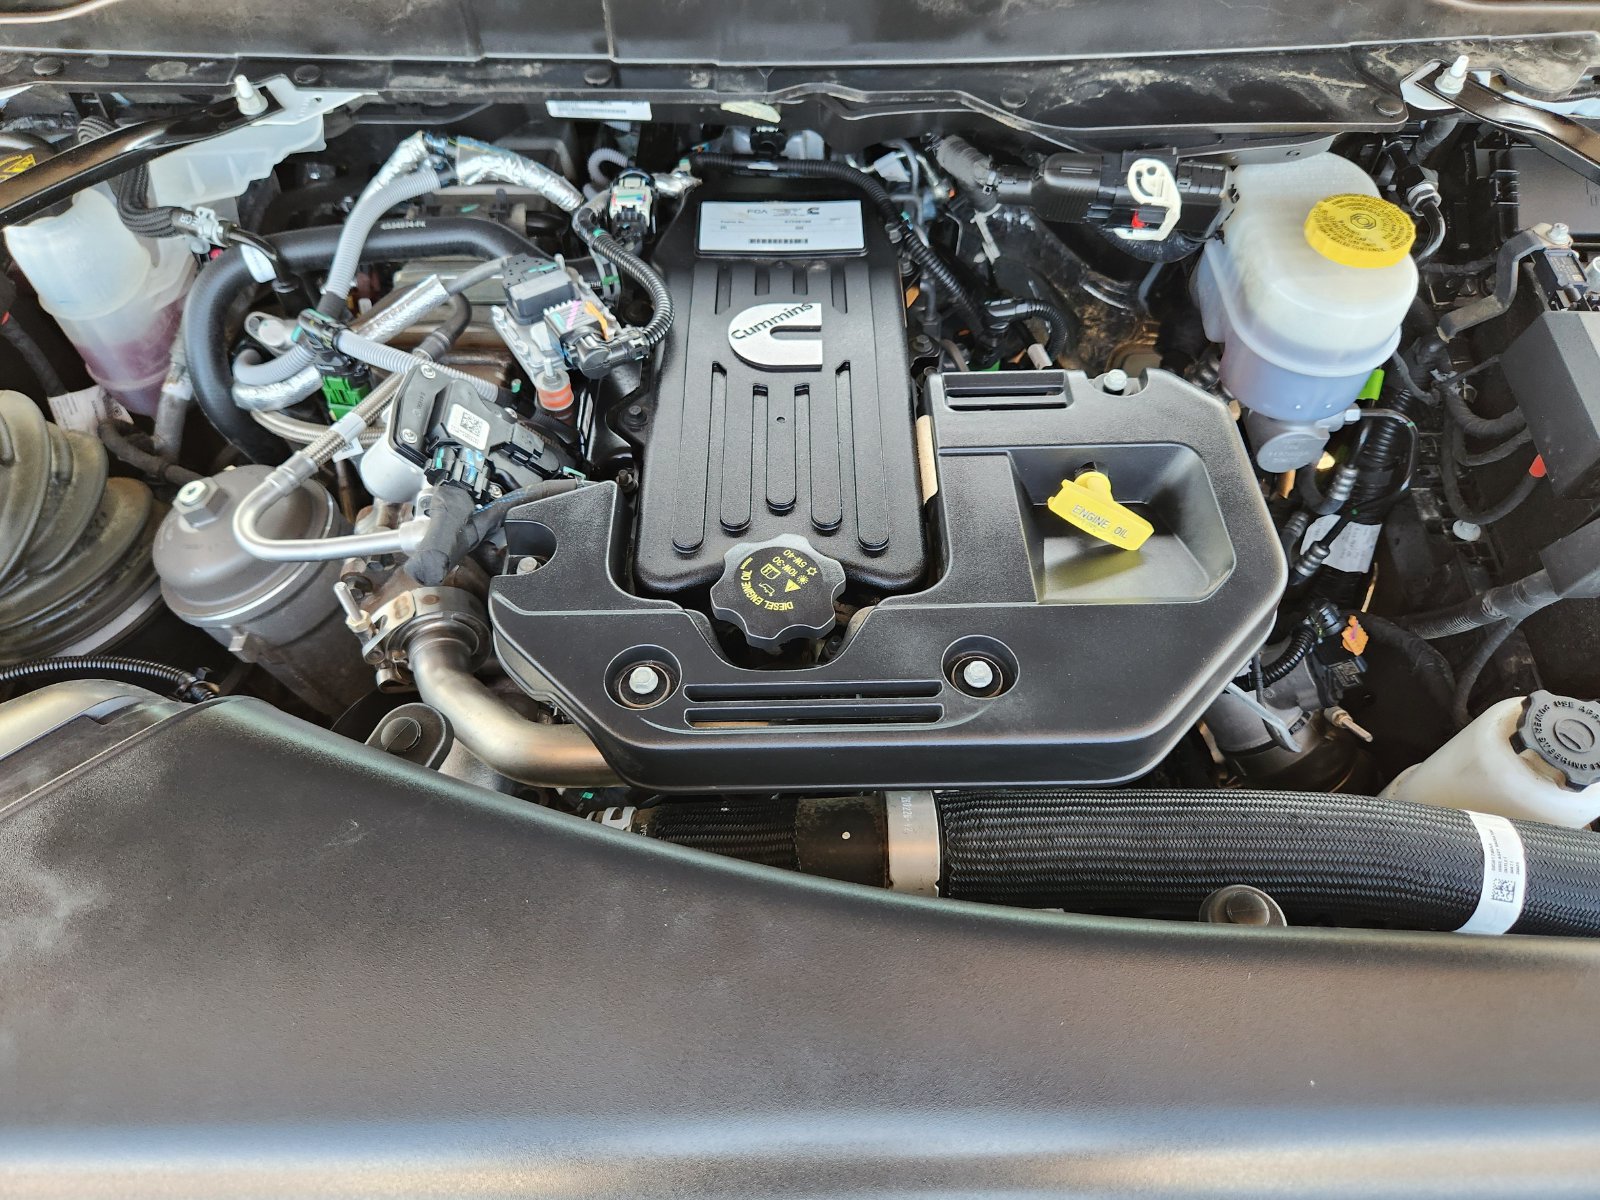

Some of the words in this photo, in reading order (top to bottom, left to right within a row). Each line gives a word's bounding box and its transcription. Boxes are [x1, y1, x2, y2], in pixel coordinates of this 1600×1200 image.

[730, 303, 813, 340] Cummins
[1072, 504, 1111, 529] ENGINE
[1113, 525, 1129, 539] OIL
[772, 556, 800, 577] 10W-30
[783, 549, 808, 568] 5W-40
[740, 569, 753, 581] OIL
[741, 581, 764, 606] ENGINE
[764, 600, 794, 611] DIESEL
